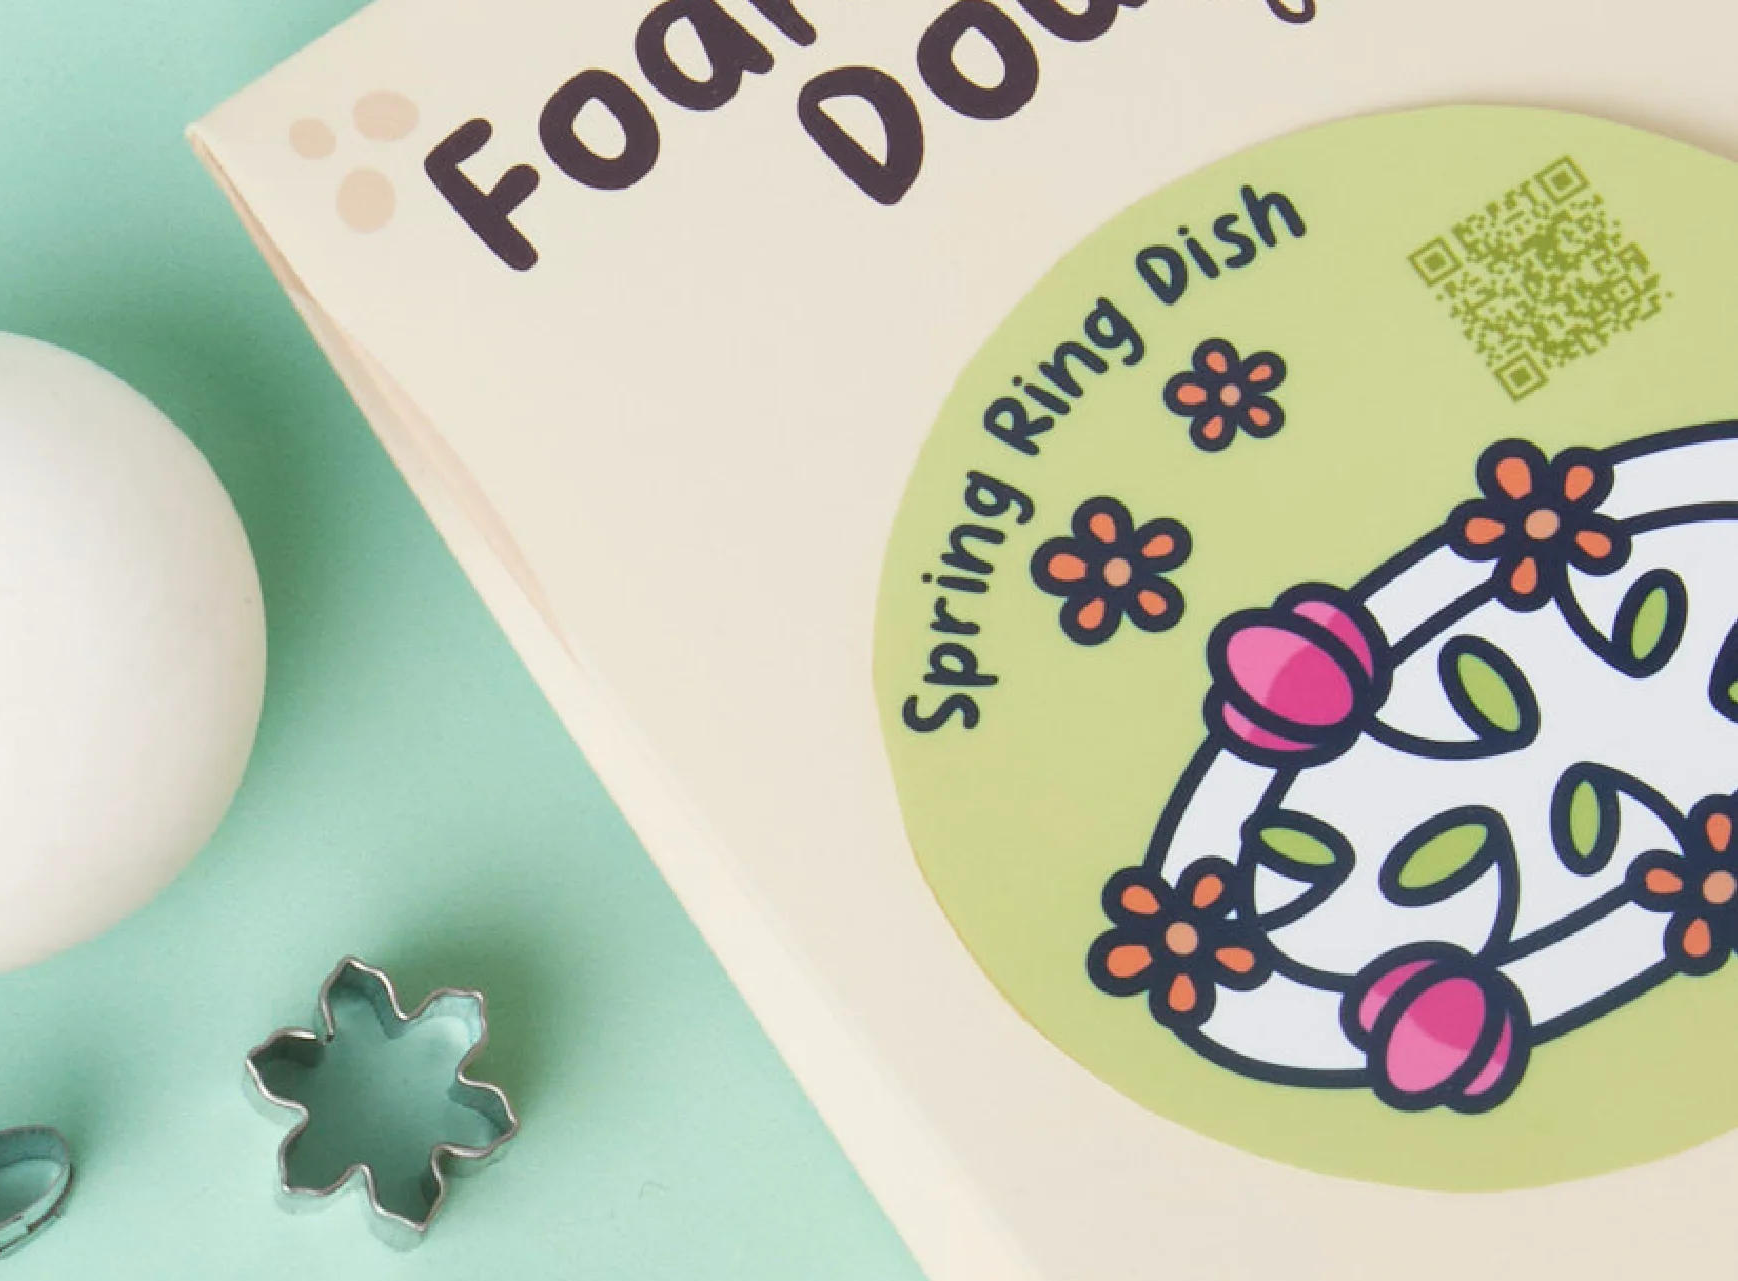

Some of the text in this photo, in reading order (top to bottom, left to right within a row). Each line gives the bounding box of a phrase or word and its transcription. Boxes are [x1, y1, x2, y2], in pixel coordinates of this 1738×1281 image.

[901, 184, 1308, 734] Spring Ring Dish
